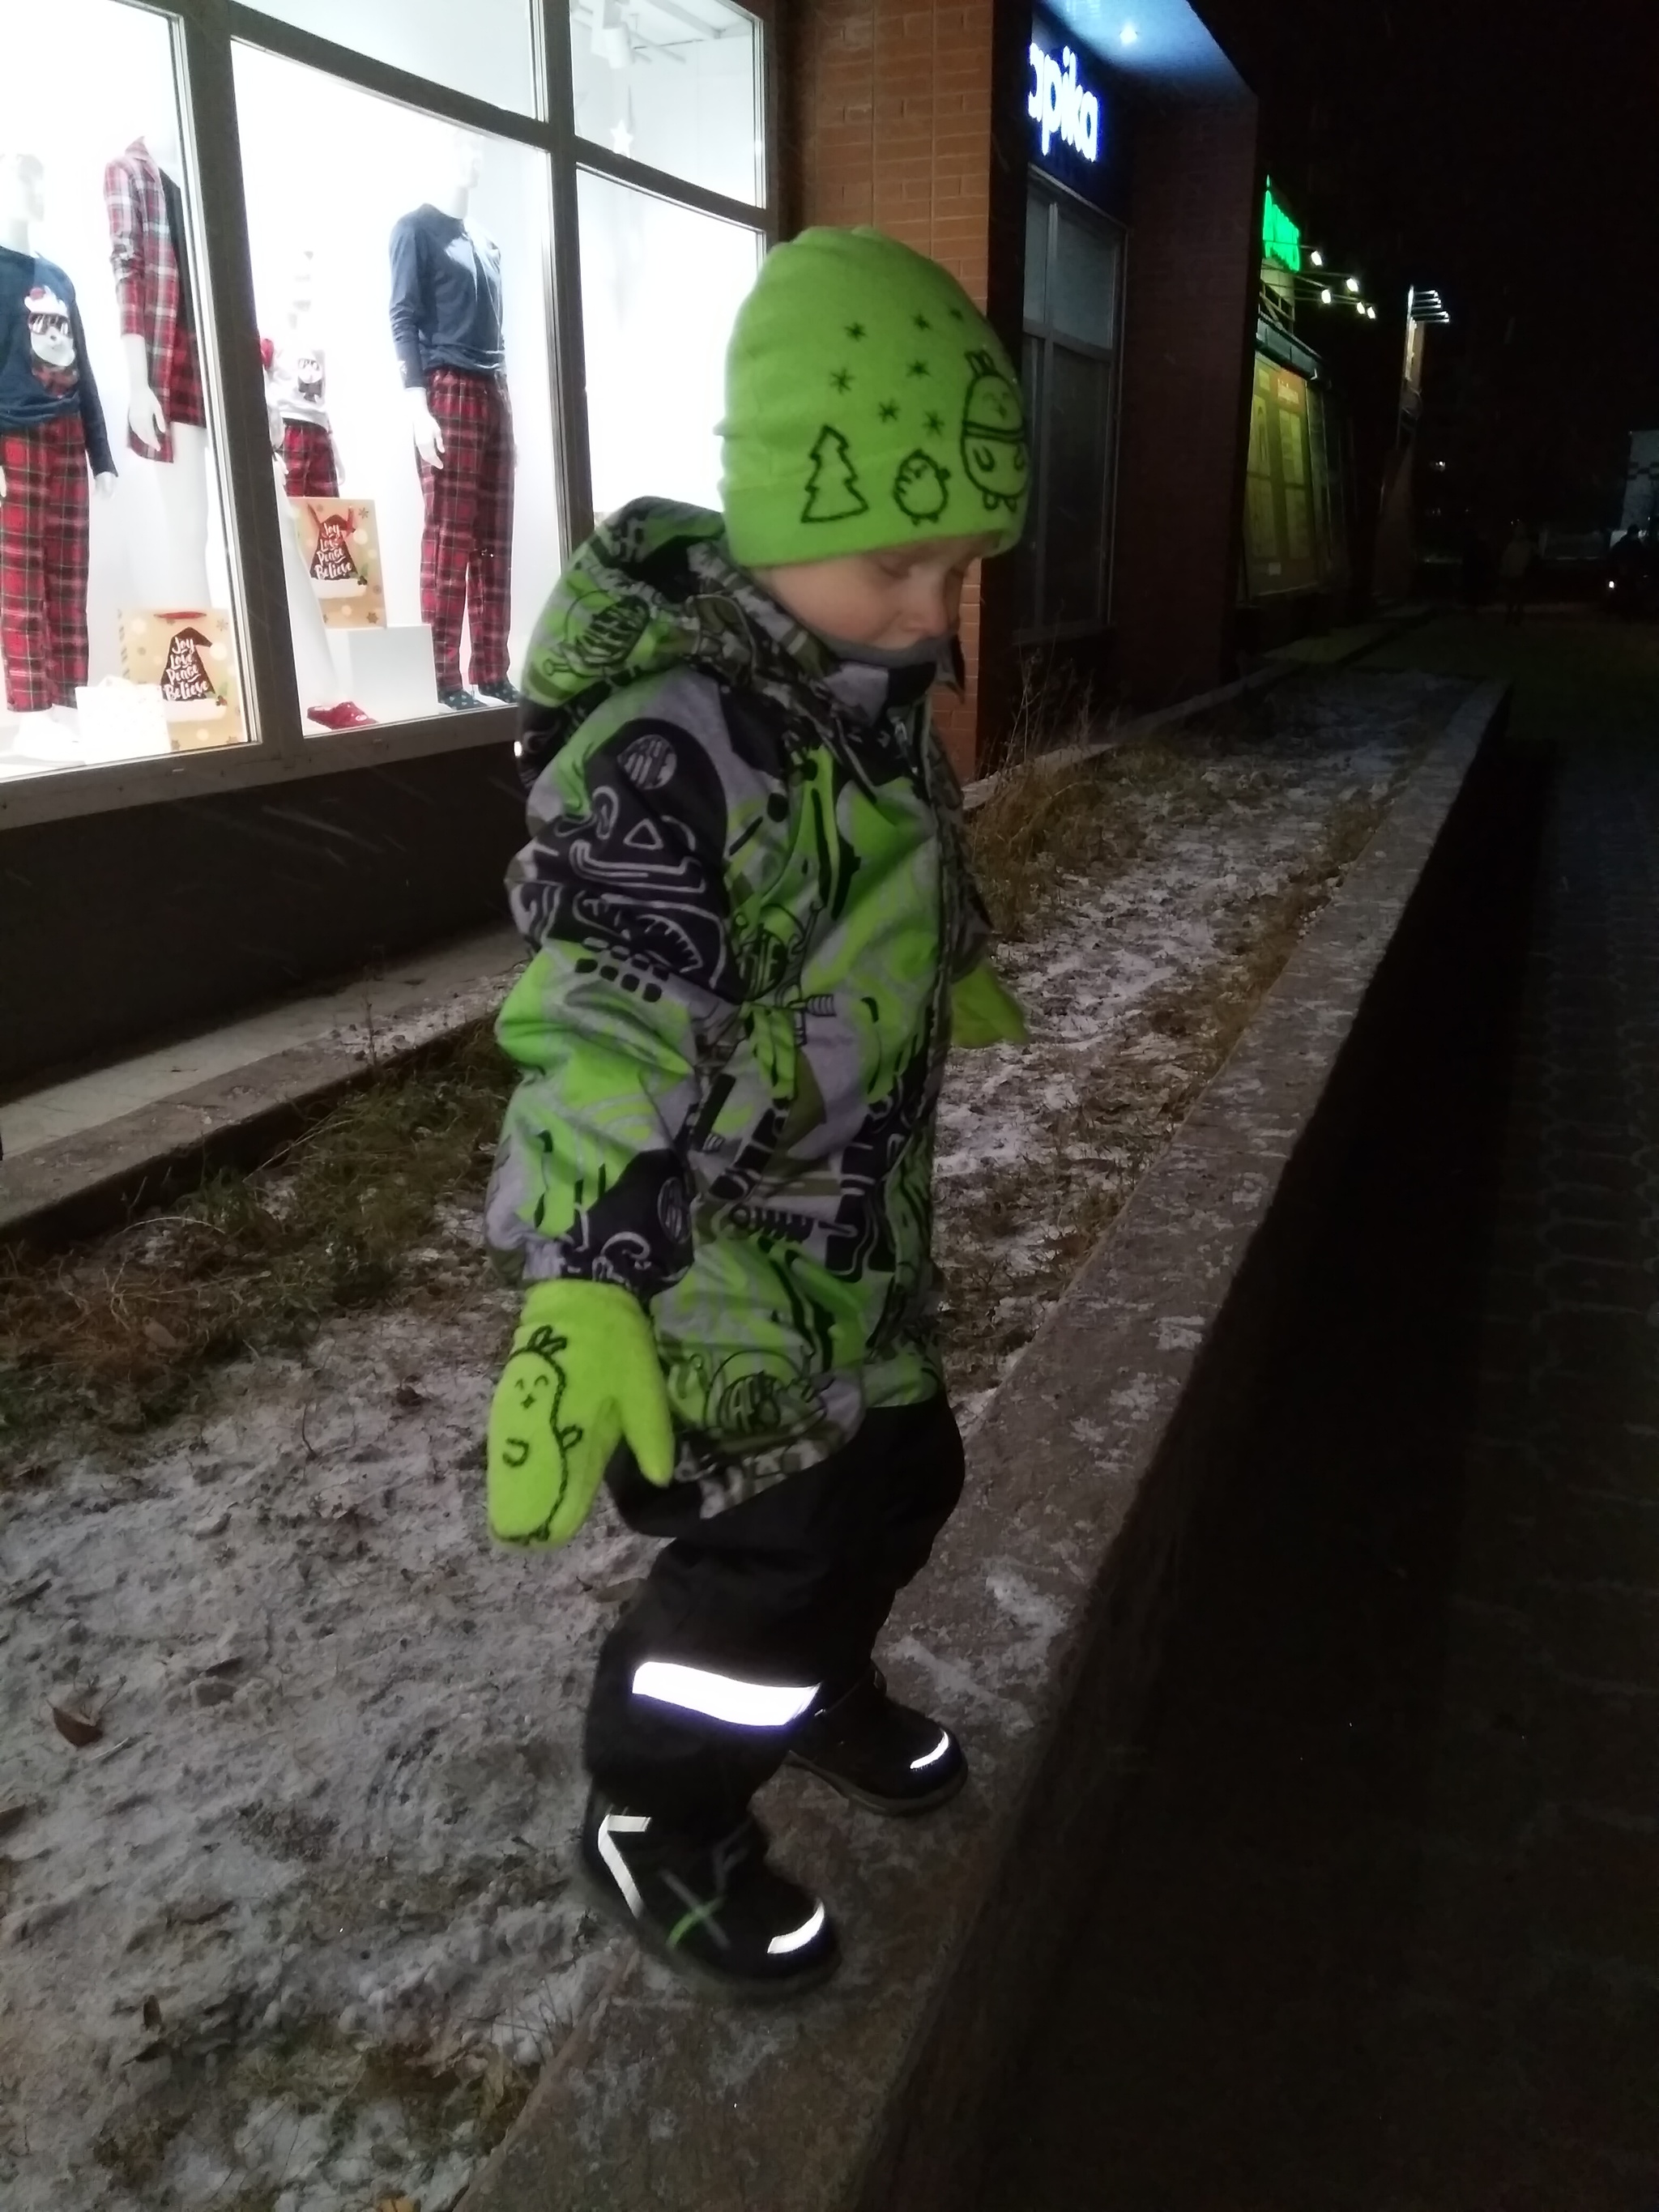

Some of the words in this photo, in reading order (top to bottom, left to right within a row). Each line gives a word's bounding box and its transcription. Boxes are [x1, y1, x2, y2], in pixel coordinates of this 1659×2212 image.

[322, 522, 341, 538] Joy
[317, 548, 346, 565] Peace
[313, 562, 352, 580] Believe
[171, 636, 195, 654] Joy
[169, 654, 193, 670] Love
[165, 664, 201, 685] Peace
[163, 680, 209, 701] Believe
